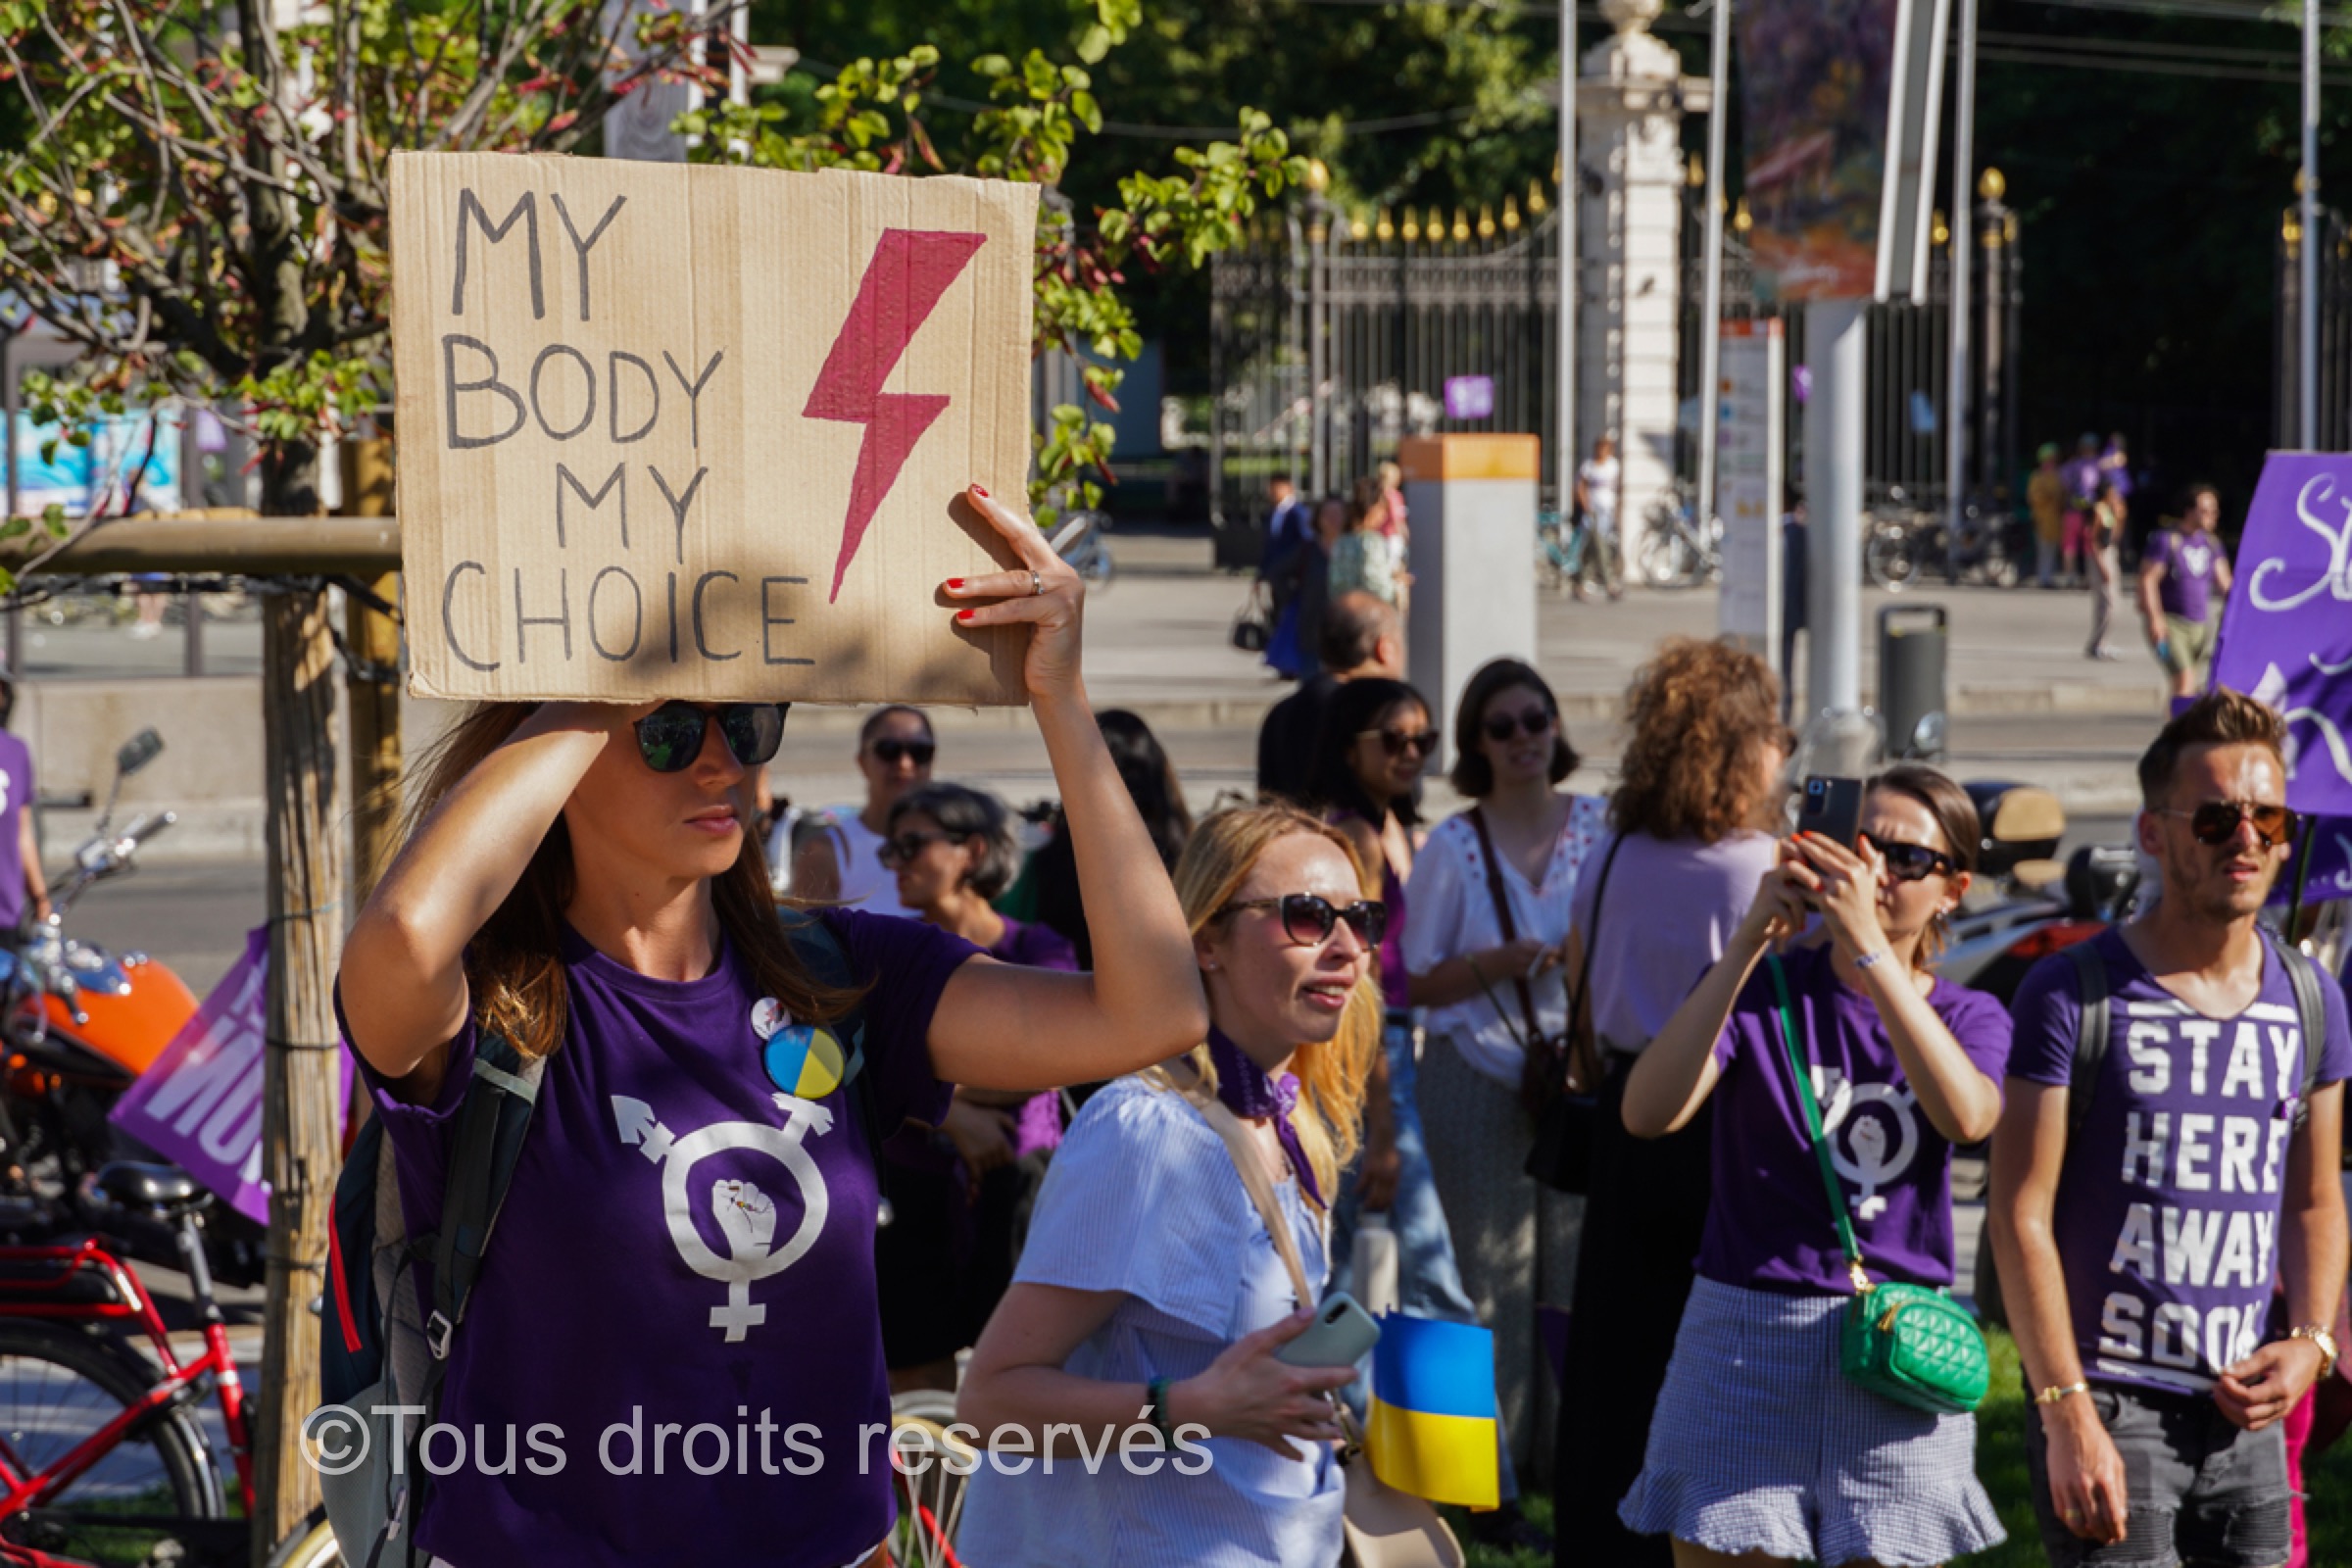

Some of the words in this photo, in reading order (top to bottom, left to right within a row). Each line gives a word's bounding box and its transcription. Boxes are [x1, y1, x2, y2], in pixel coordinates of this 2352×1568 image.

[452, 186, 627, 321] MY
[441, 333, 727, 450] BODY
[555, 461, 710, 565] MY
[442, 560, 816, 672] CHOICE
[2127, 1019, 2300, 1100] STAY
[2122, 1111, 2288, 1194] HERE
[2109, 1201, 2275, 1288] AWAY
